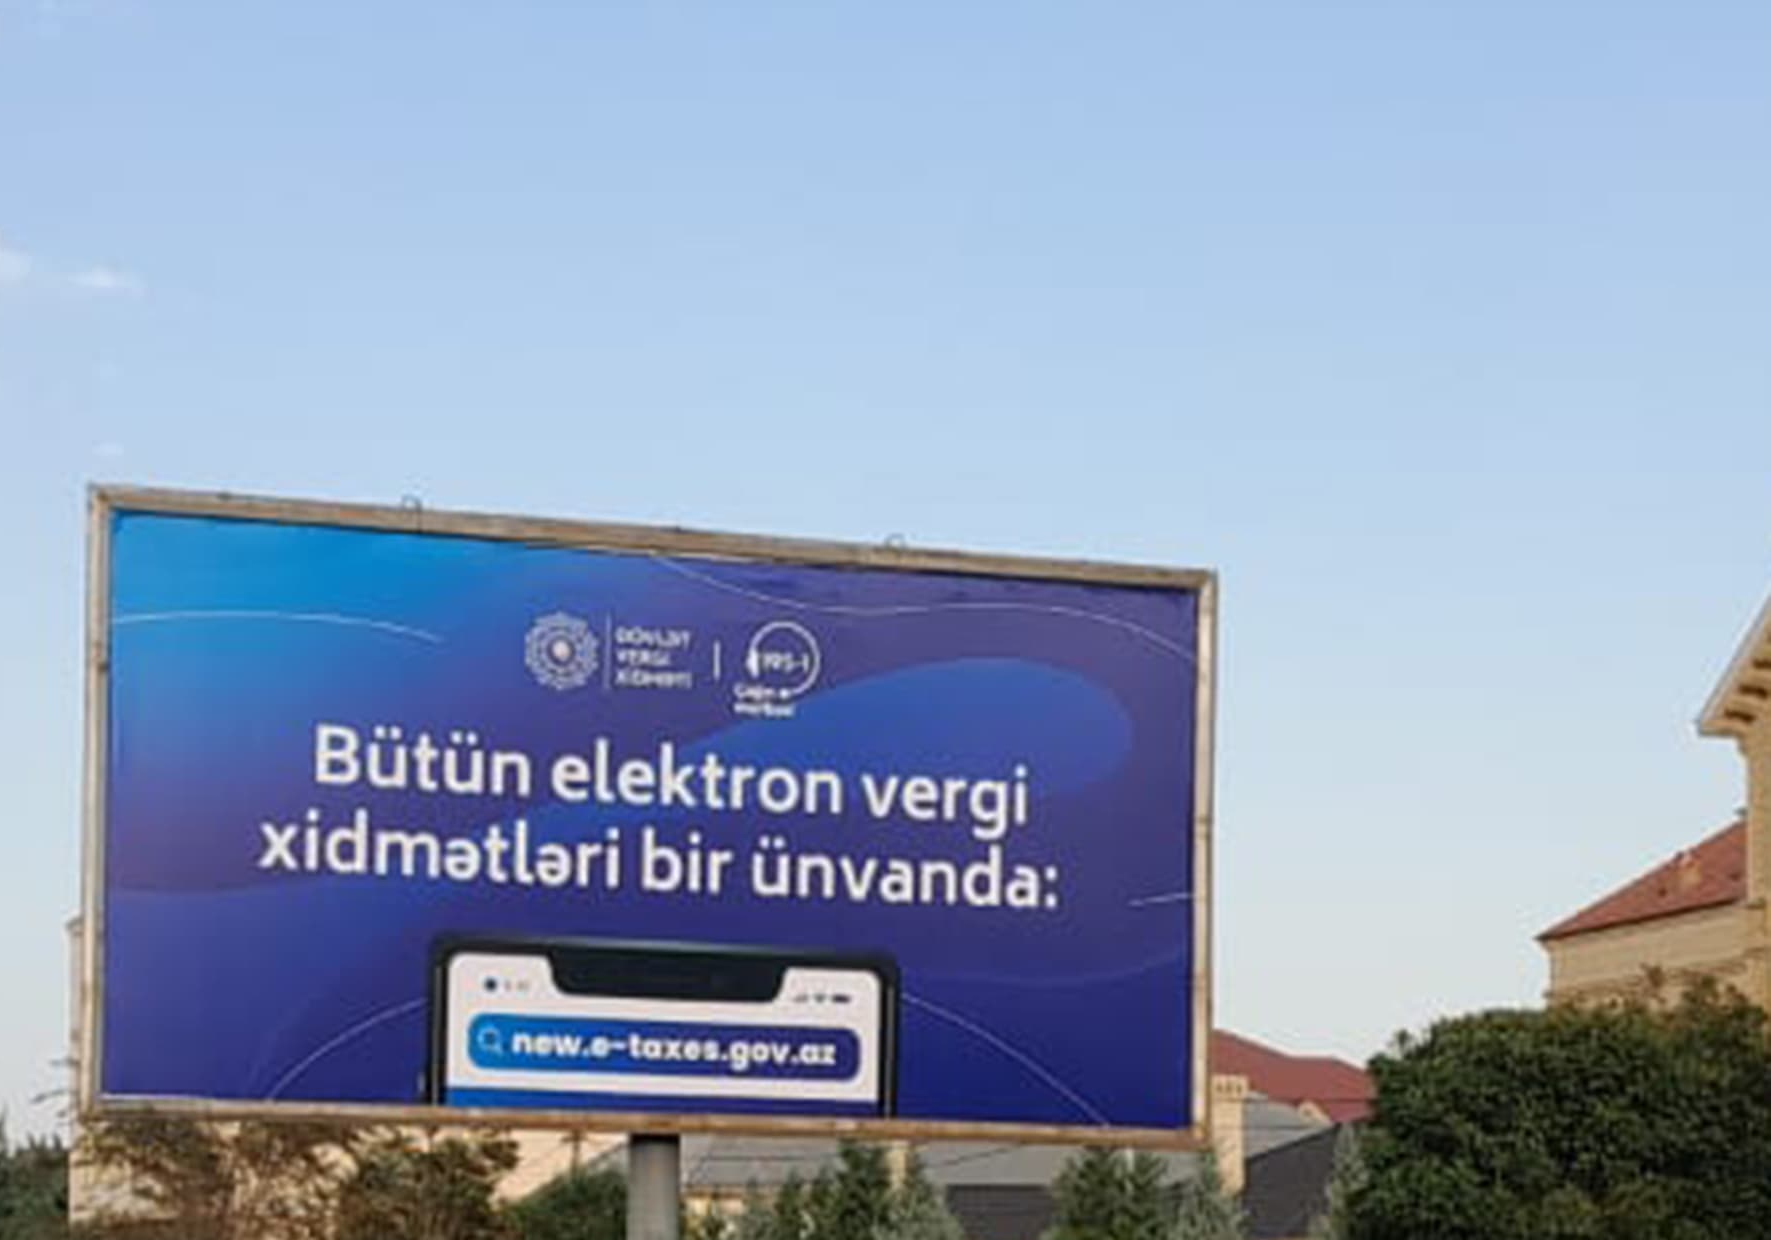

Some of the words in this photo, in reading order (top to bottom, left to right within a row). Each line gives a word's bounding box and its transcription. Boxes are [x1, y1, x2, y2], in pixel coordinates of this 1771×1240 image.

[313, 724, 531, 797] Bütün
[550, 737, 843, 815] elektron
[861, 765, 1027, 841] vergi
[258, 807, 620, 888] xidmətləri
[641, 826, 734, 894] bir
[751, 835, 1058, 909] ünvanda:
[511, 1028, 837, 1071] new.e-taxes.gov.az
